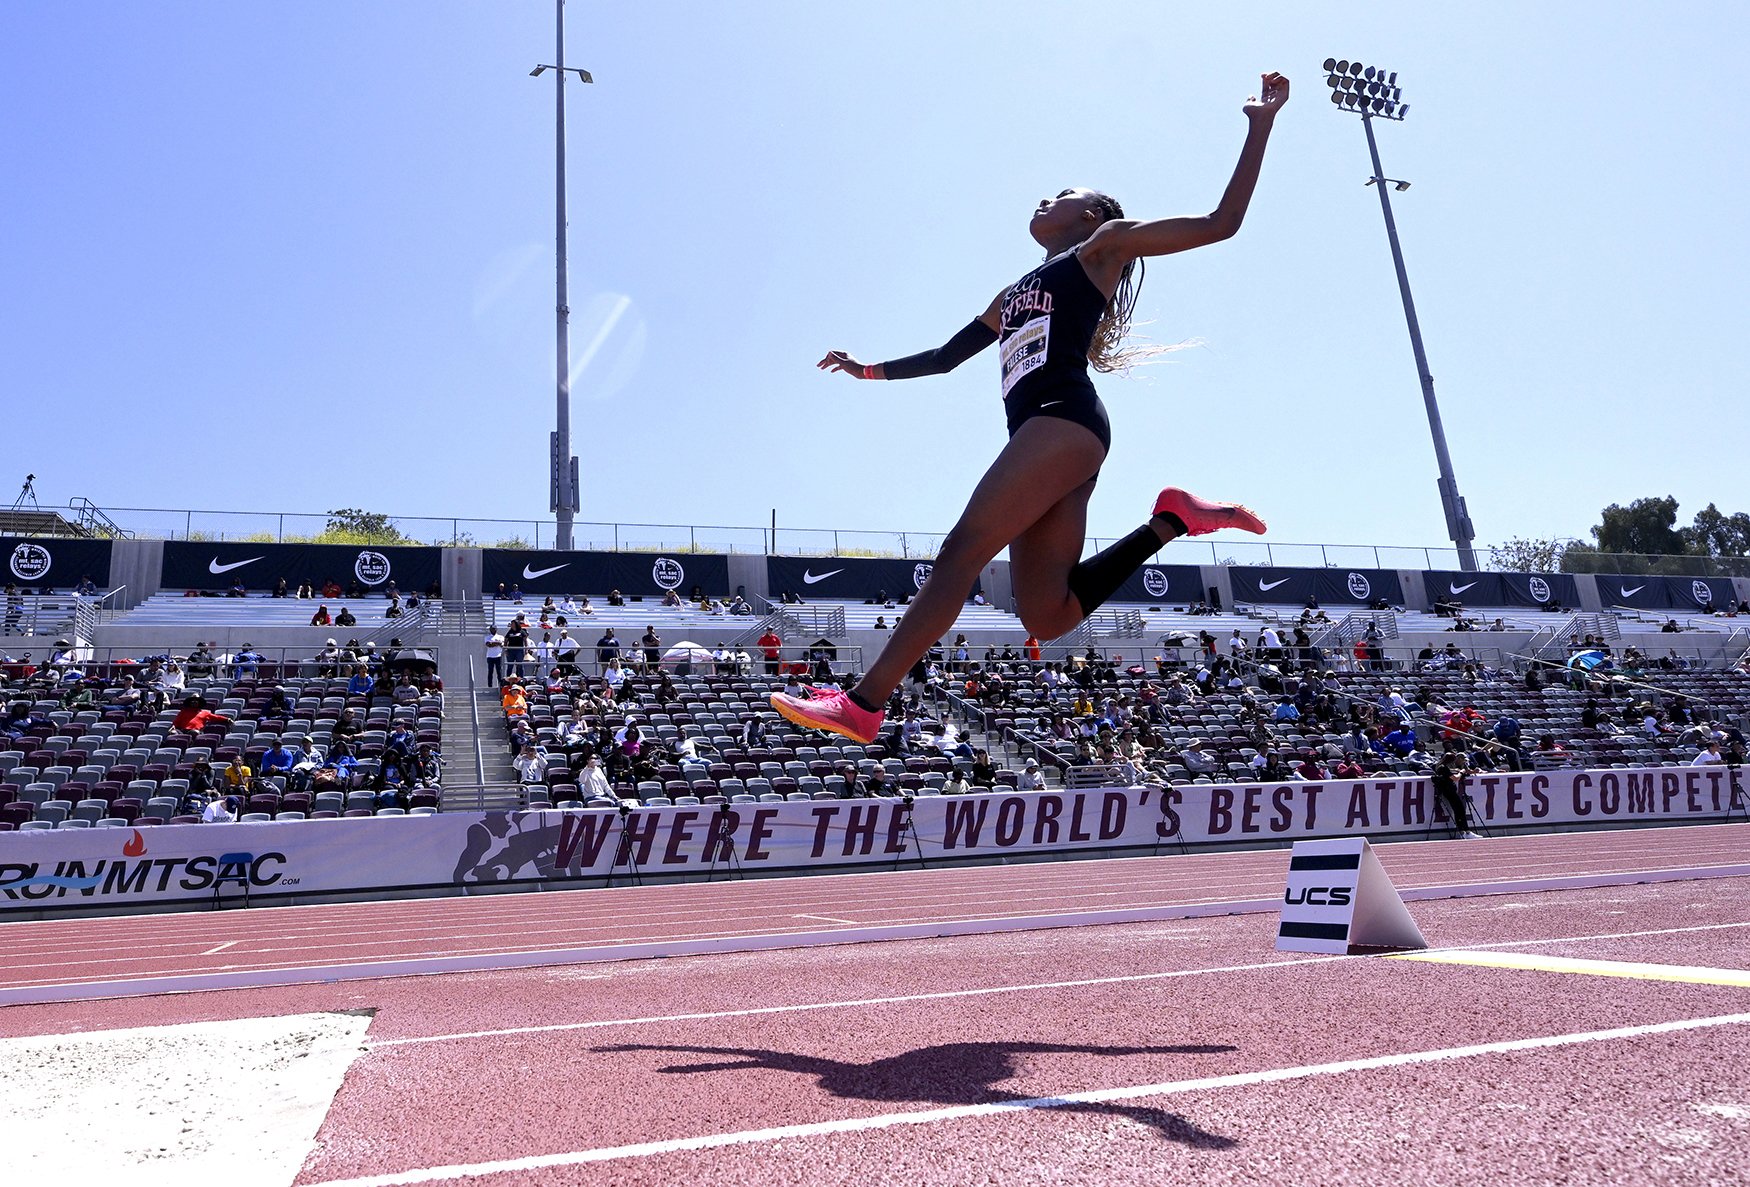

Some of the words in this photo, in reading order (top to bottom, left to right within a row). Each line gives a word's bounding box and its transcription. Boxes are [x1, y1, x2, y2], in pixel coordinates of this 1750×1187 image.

[1022, 354, 1041, 371] 1884
[554, 808, 779, 869] WHERE
[809, 803, 915, 857] THE
[943, 789, 1183, 849] WORLD'S
[1207, 785, 1324, 835] BEST
[1572, 771, 1744, 816] COMPETE
[1284, 886, 1351, 905] UCS
